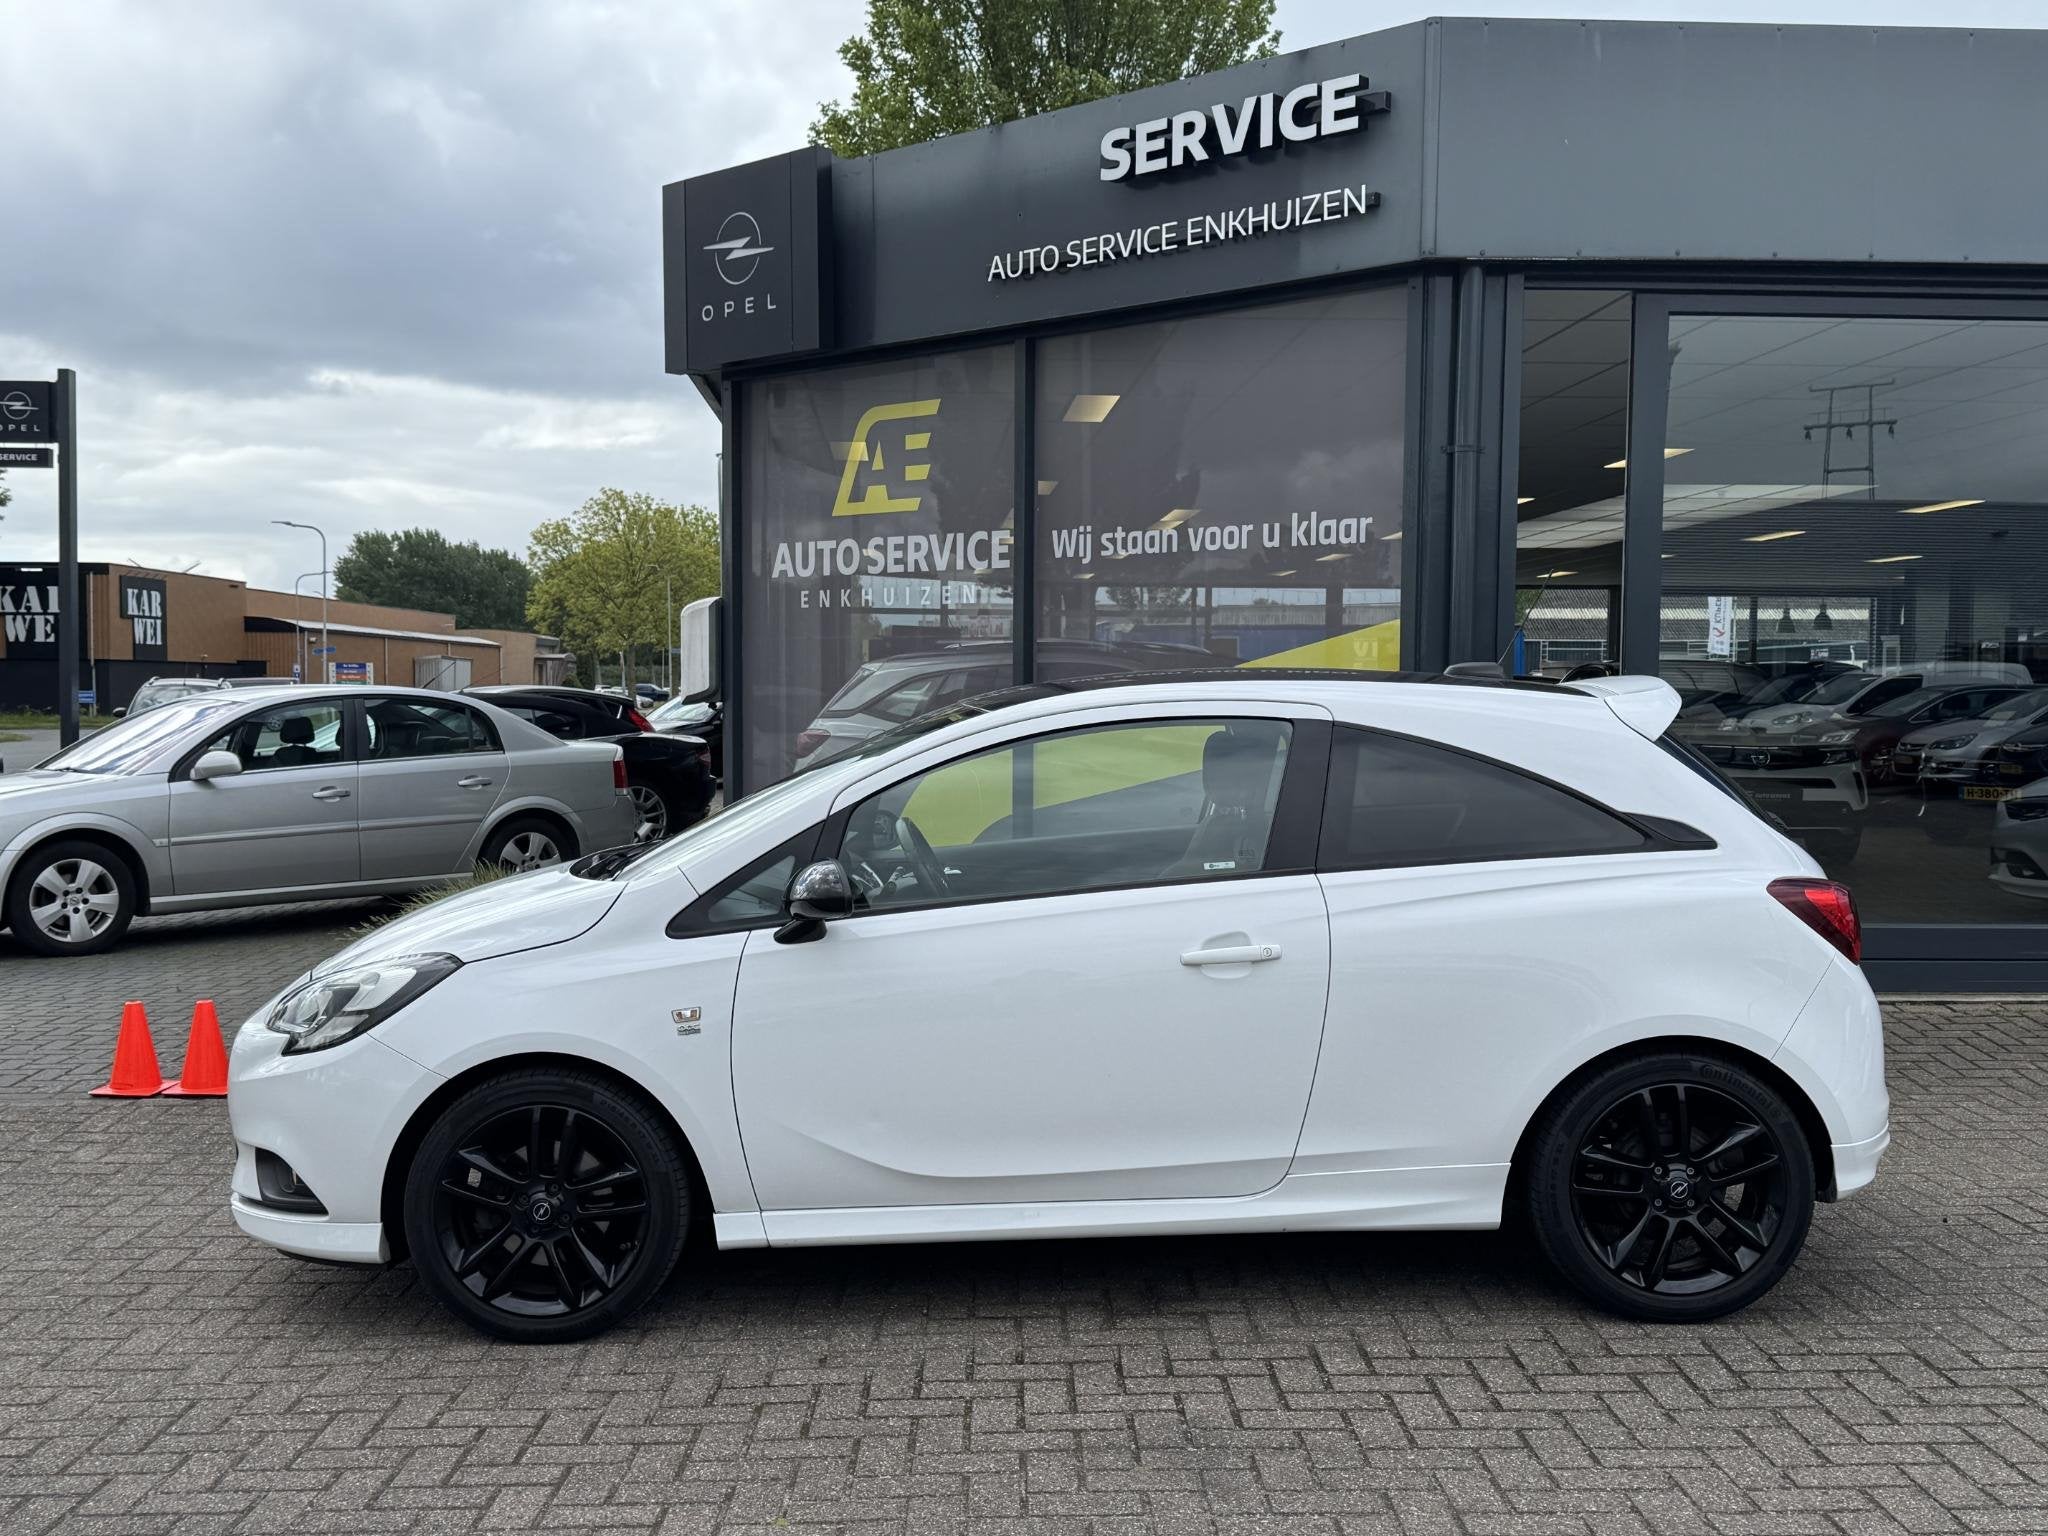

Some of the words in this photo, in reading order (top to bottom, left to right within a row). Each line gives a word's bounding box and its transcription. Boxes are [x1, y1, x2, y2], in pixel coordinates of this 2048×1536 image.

[1100, 73, 1361, 181] SERVICE
[987, 245, 1060, 282] AUTO
[1066, 221, 1178, 268] SERVICE
[1187, 184, 1367, 246] ENKHUIZEN
[702, 293, 776, 321] OPEL
[772, 538, 860, 578] AUTO
[867, 530, 1011, 575] SERVICE
[1052, 525, 1092, 564] Wij
[1100, 526, 1178, 558] staan
[1187, 522, 1253, 552] voor
[1263, 522, 1280, 548] u
[1291, 511, 1373, 547] klaar
[127, 588, 162, 617] KAR
[801, 584, 976, 608] ENKHUIZEN
[133, 617, 163, 645] WEI
